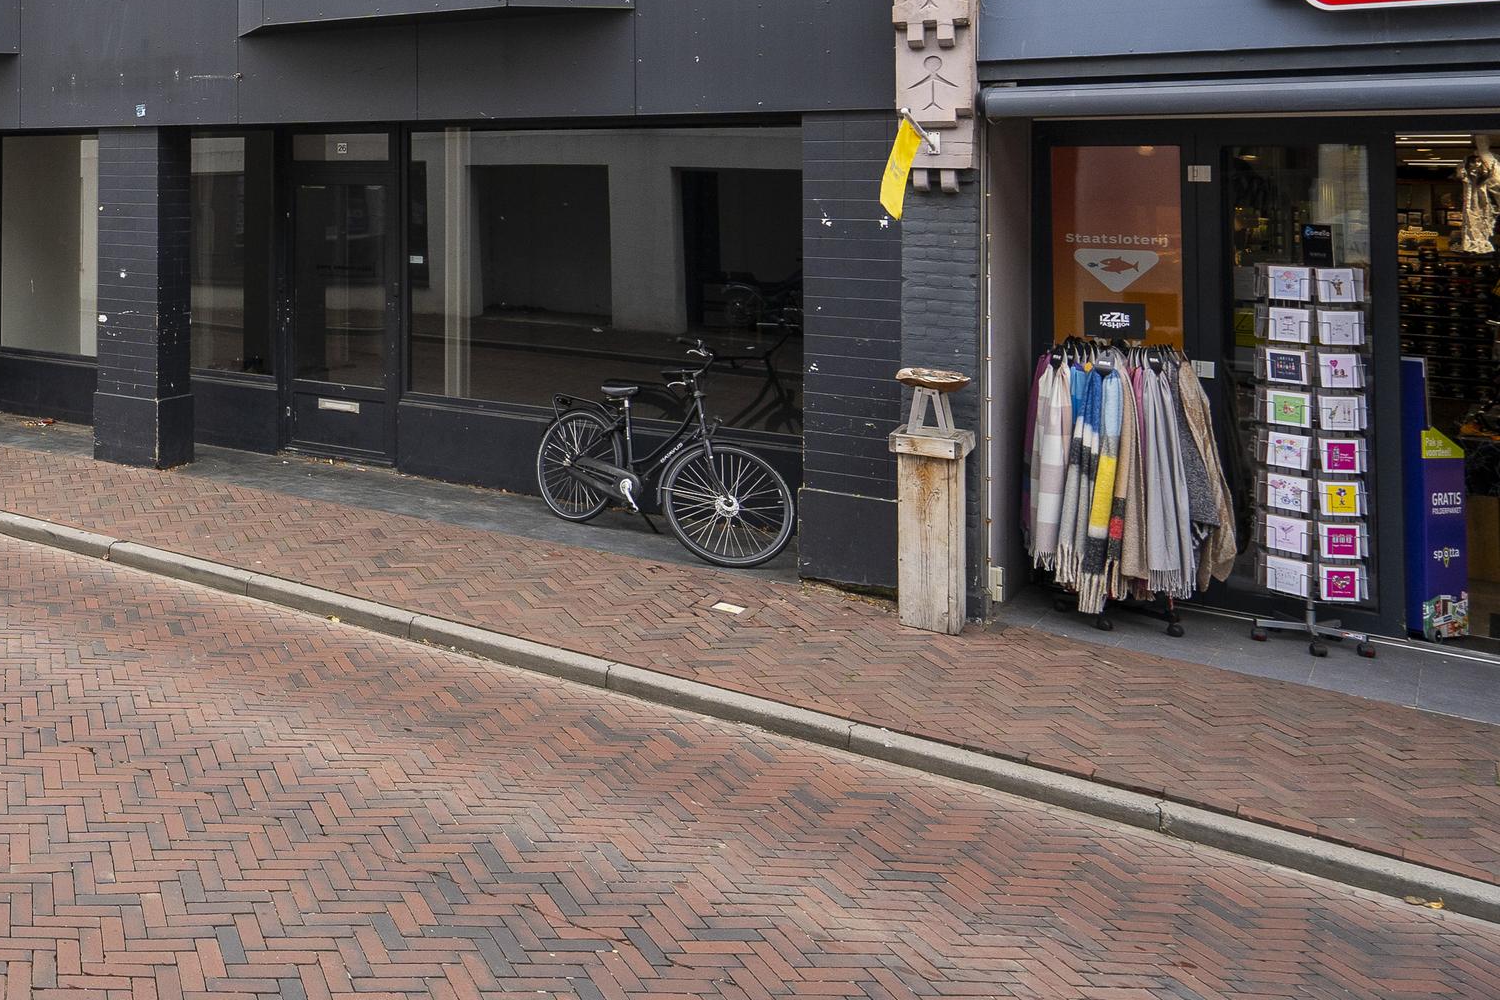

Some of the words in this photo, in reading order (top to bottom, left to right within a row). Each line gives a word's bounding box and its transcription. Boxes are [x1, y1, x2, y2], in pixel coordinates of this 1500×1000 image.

[1065, 233, 1169, 248] Staatsloterij
[1431, 492, 1462, 506] GRATIS
[1433, 547, 1460, 561] spotta
